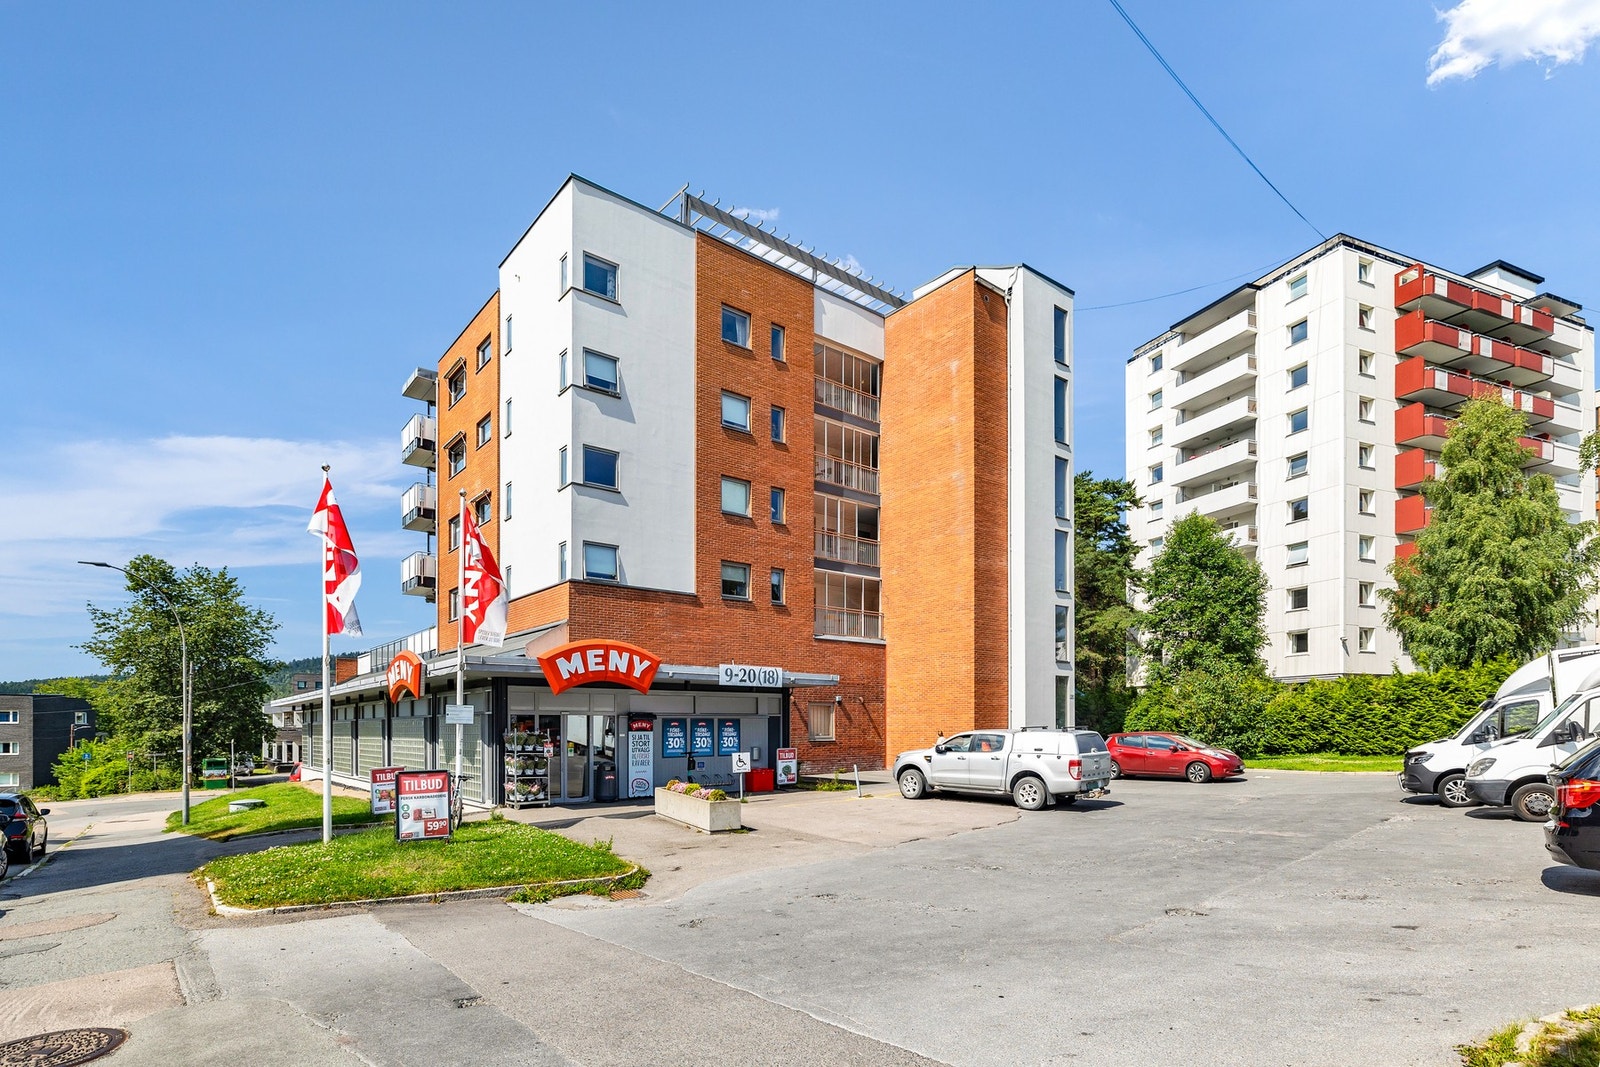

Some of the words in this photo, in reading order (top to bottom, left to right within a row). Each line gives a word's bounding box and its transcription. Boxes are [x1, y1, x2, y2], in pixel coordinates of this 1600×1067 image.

[388, 659, 413, 690] MENY
[555, 649, 651, 680] MENY
[376, 773, 396, 781] TILBU
[404, 778, 443, 791] TILBUD
